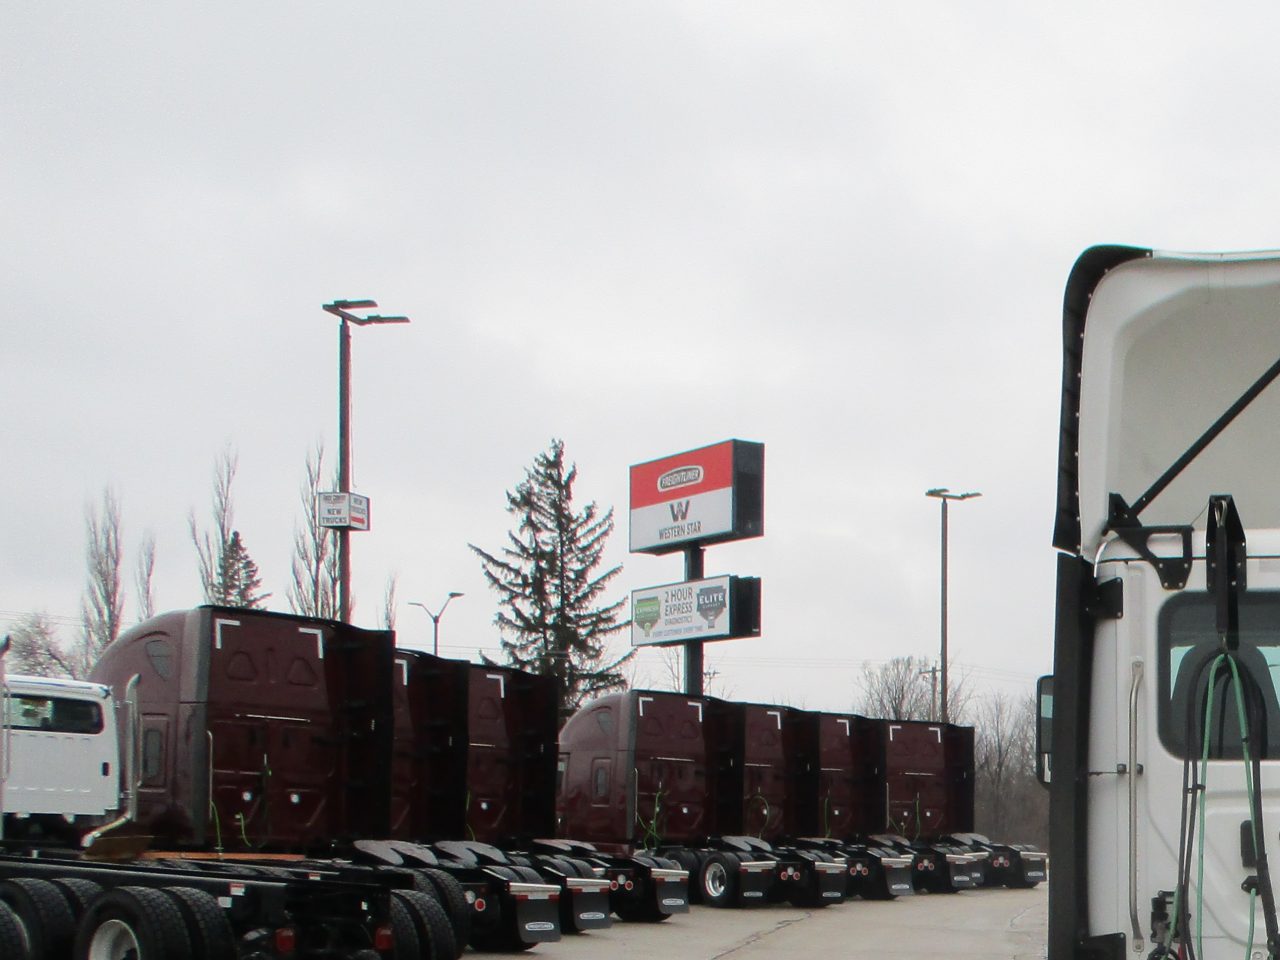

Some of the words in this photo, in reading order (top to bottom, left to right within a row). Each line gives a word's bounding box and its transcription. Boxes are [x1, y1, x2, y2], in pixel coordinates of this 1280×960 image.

[659, 524, 686, 540] WESTERN
[687, 521, 701, 535] STAR
[665, 591, 669, 603] 2
[671, 587, 693, 602] HOUR
[699, 593, 724, 605] ELITE
[665, 602, 693, 616] EXPRESS
